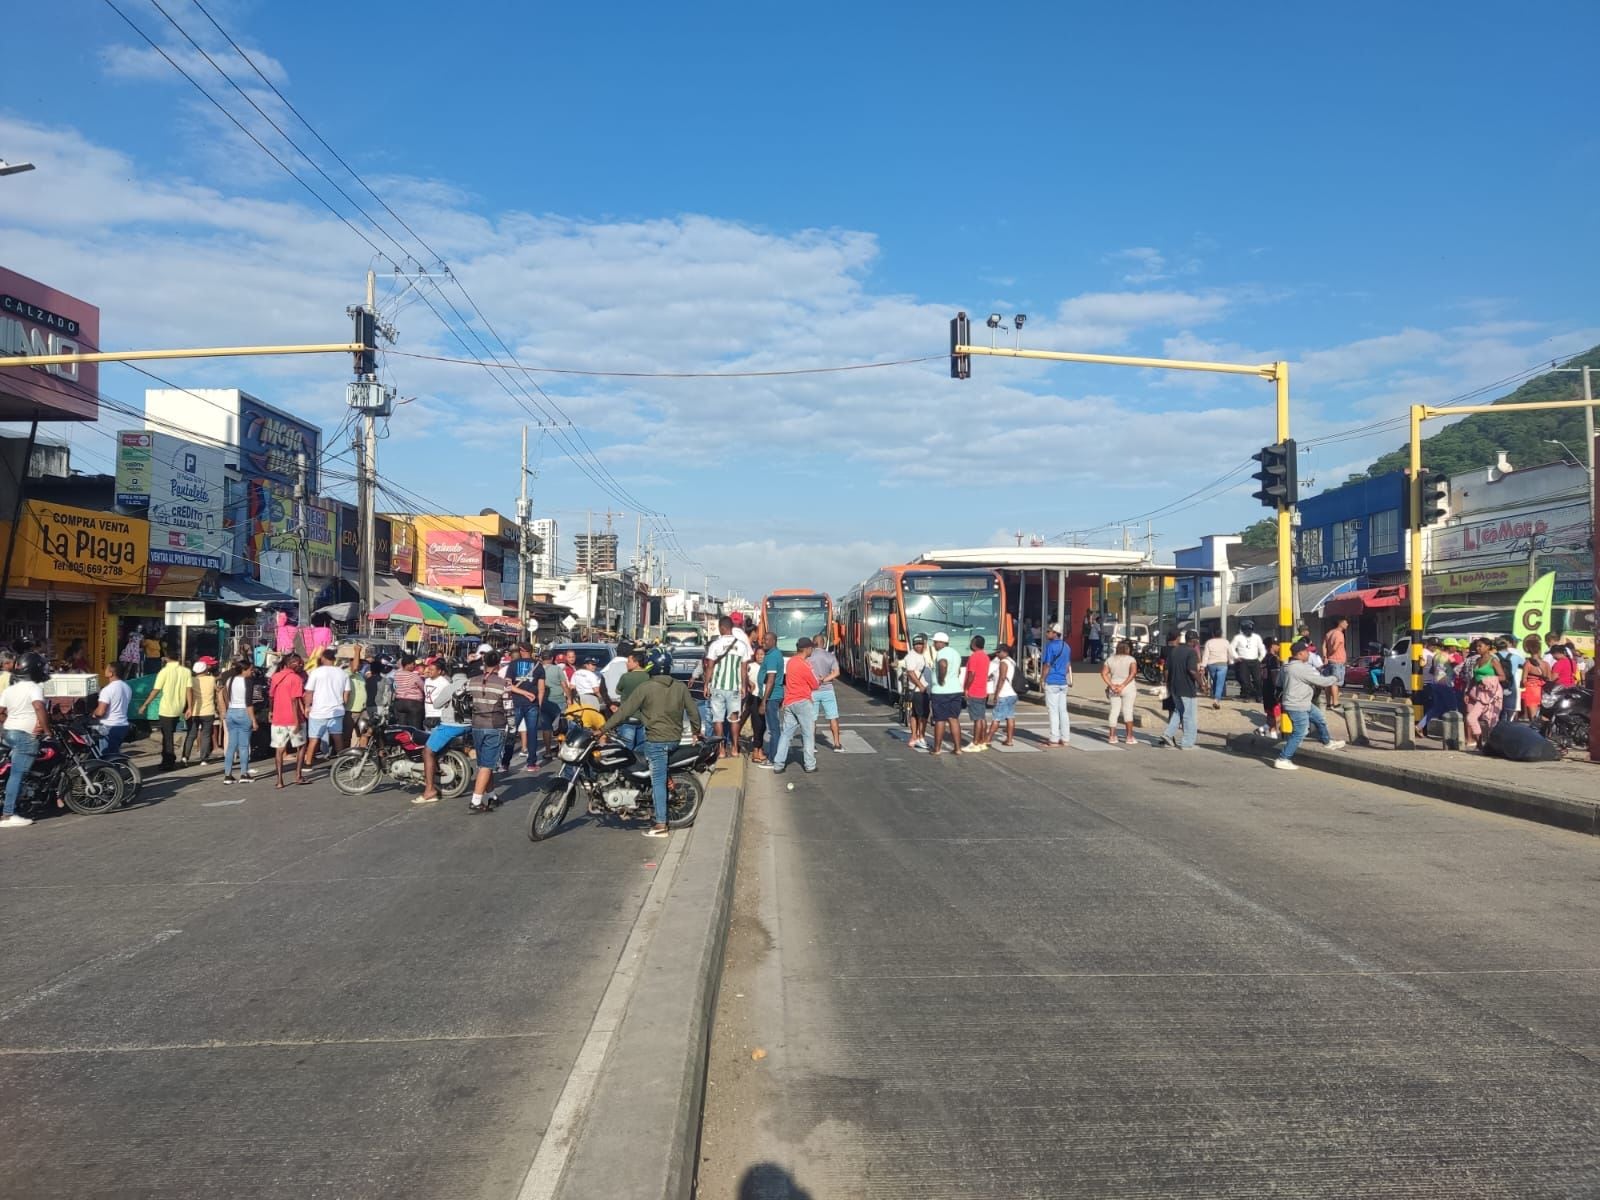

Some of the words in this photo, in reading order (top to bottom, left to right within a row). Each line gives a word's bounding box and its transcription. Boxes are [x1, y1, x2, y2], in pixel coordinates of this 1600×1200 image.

[4, 297, 76, 333] CALZADO
[53, 512, 96, 529] COMPRA
[99, 520, 130, 534] VENTA
[172, 506, 203, 522] CREDITO
[42, 524, 69, 563] La
[76, 530, 135, 565] Playa
[1321, 556, 1369, 578] DANIELA
